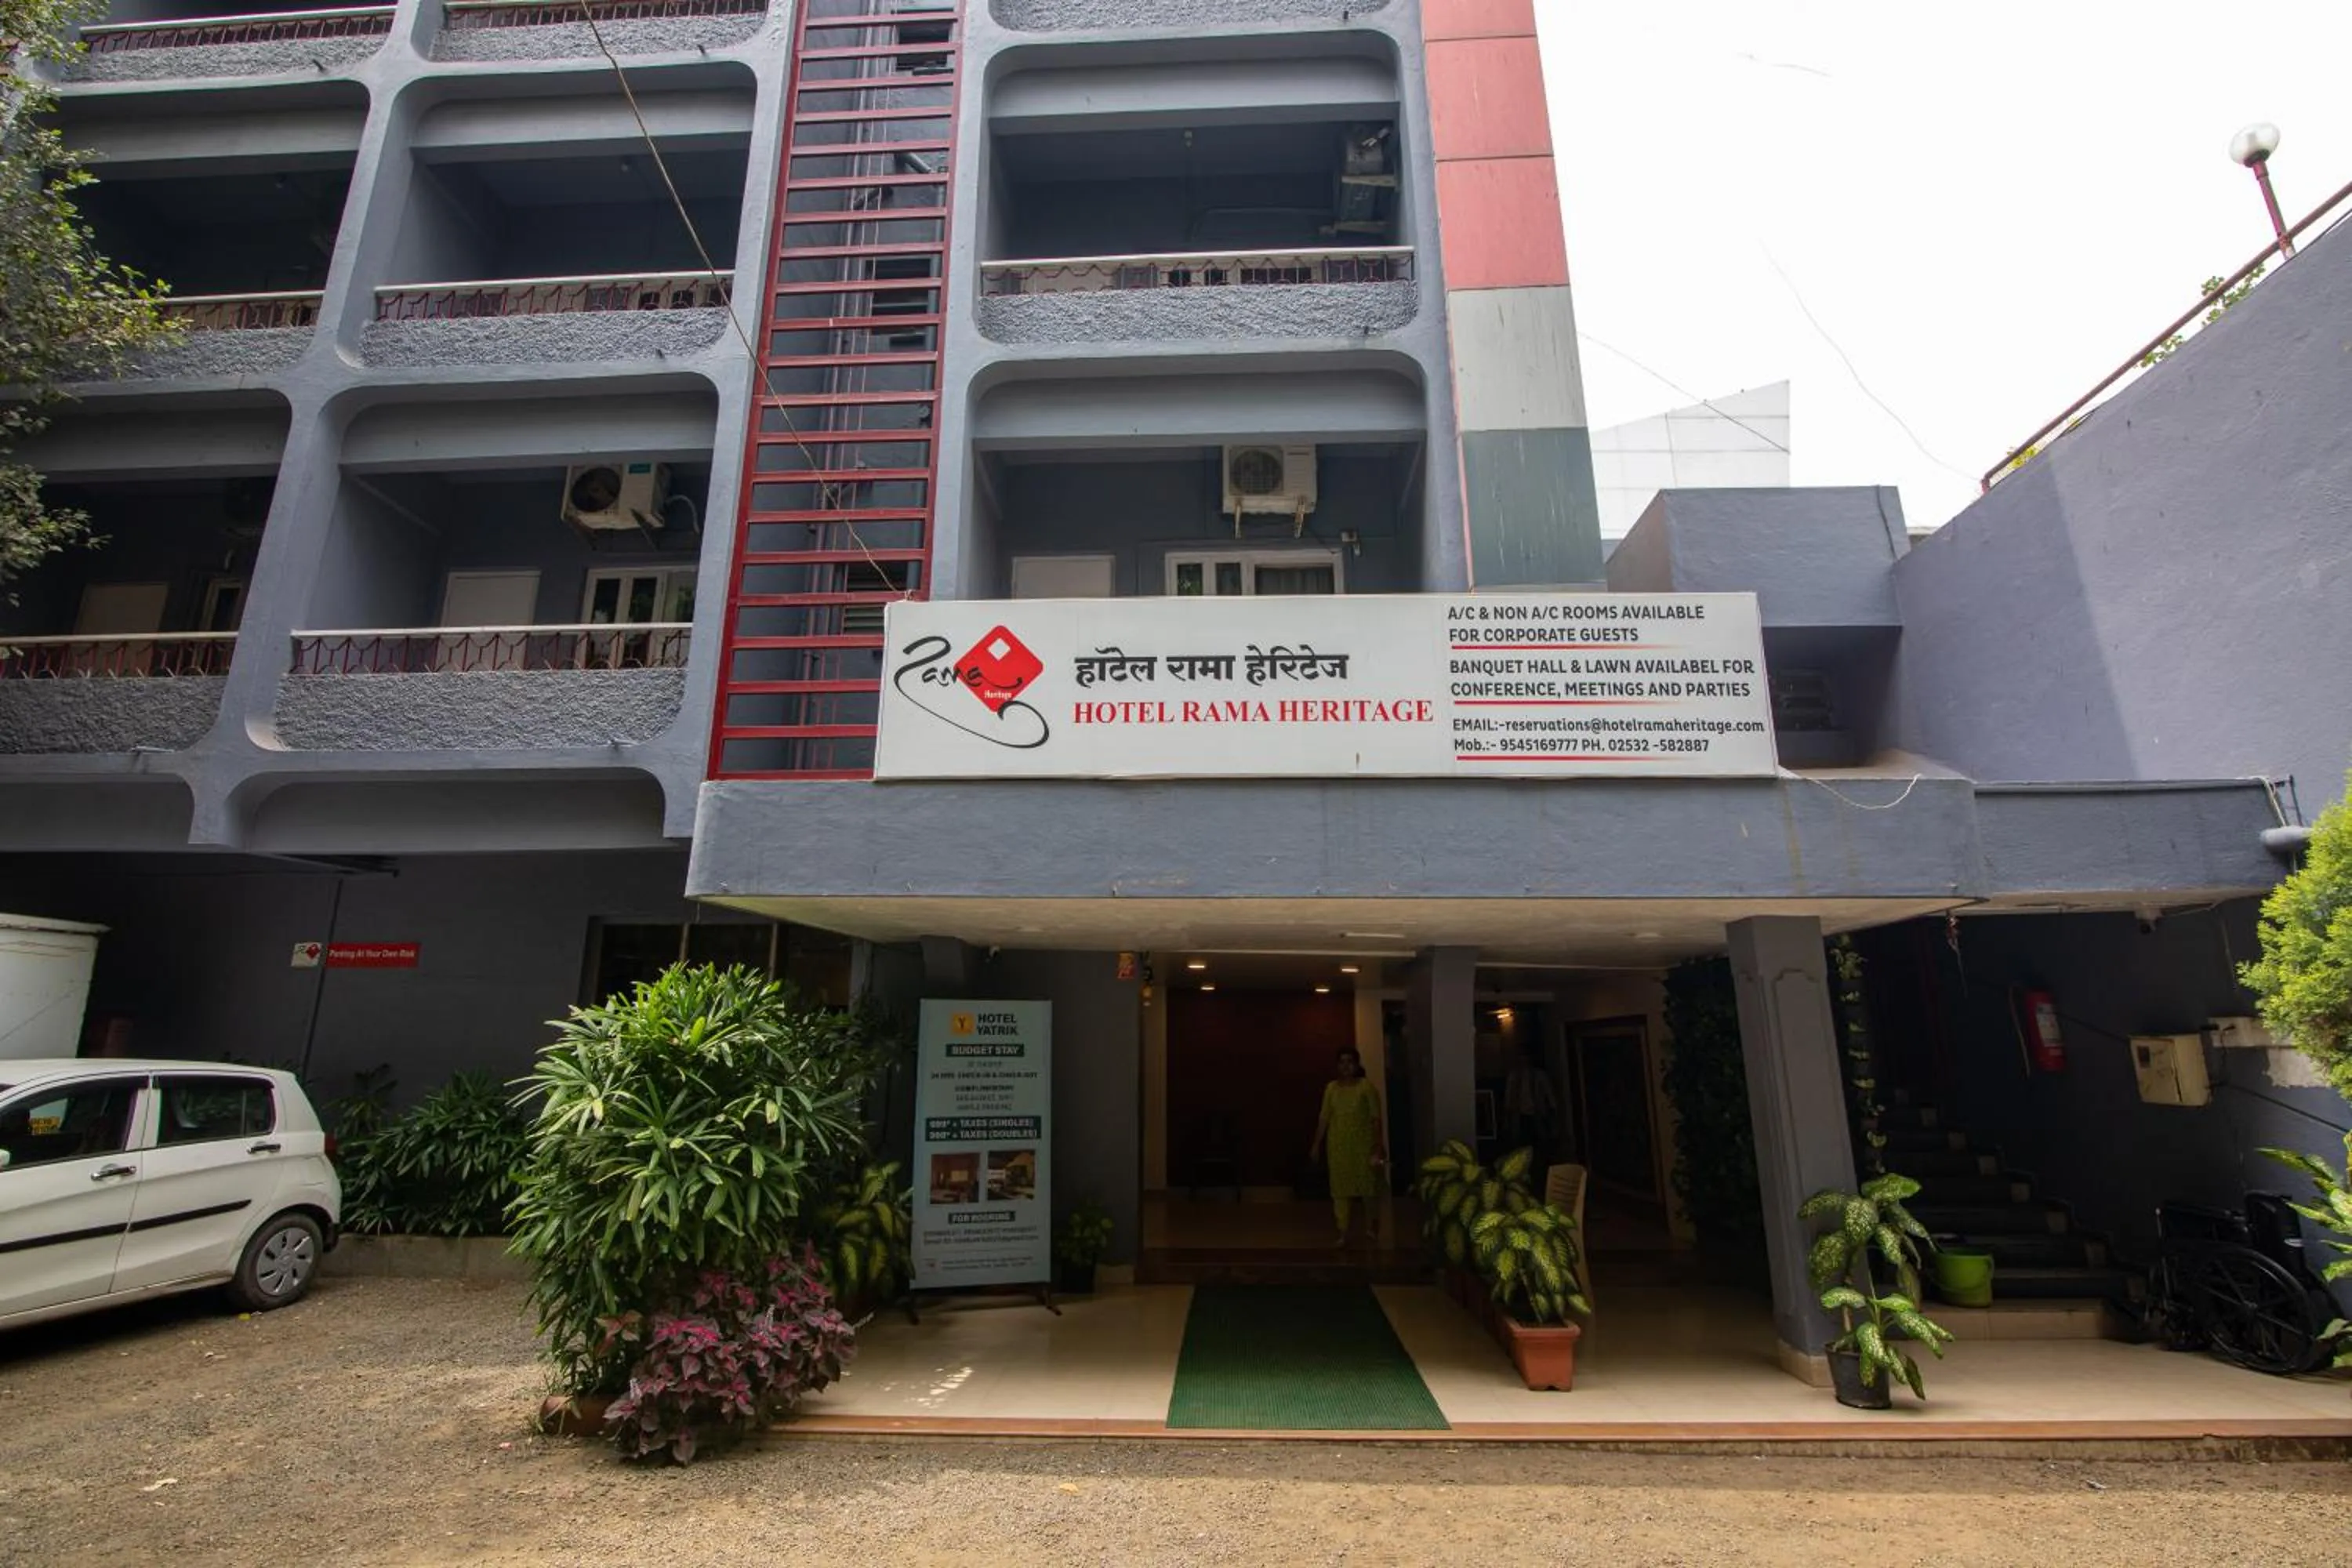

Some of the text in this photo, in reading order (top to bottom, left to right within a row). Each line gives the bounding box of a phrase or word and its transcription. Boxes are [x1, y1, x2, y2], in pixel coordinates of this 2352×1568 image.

[1448, 605, 1704, 620] A/C & NON A/C ROOMS AVAILABLE
[1450, 627, 1639, 642] FOR CORPORATE GUESTS
[1074, 644, 1349, 688] हॉटेल रामा हेरिटेज
[1450, 659, 1755, 676] BANQUET HALL & LAWN AVAILABEL FOR
[985, 690, 1012, 700] Heritage
[1451, 682, 1751, 699] CONFERENCE, MEETINGS AND PARTIES
[1073, 699, 1434, 723] HOTEL RAMA HERITAGE
[1500, 739, 1578, 752] 9545169777
[1581, 739, 1605, 751] PH.
[1608, 739, 1650, 752] 02532
[978, 1013, 1017, 1023] HOTEL
[977, 1025, 1019, 1036] YATRIK
[953, 1045, 1019, 1054] BUDGET STAY
